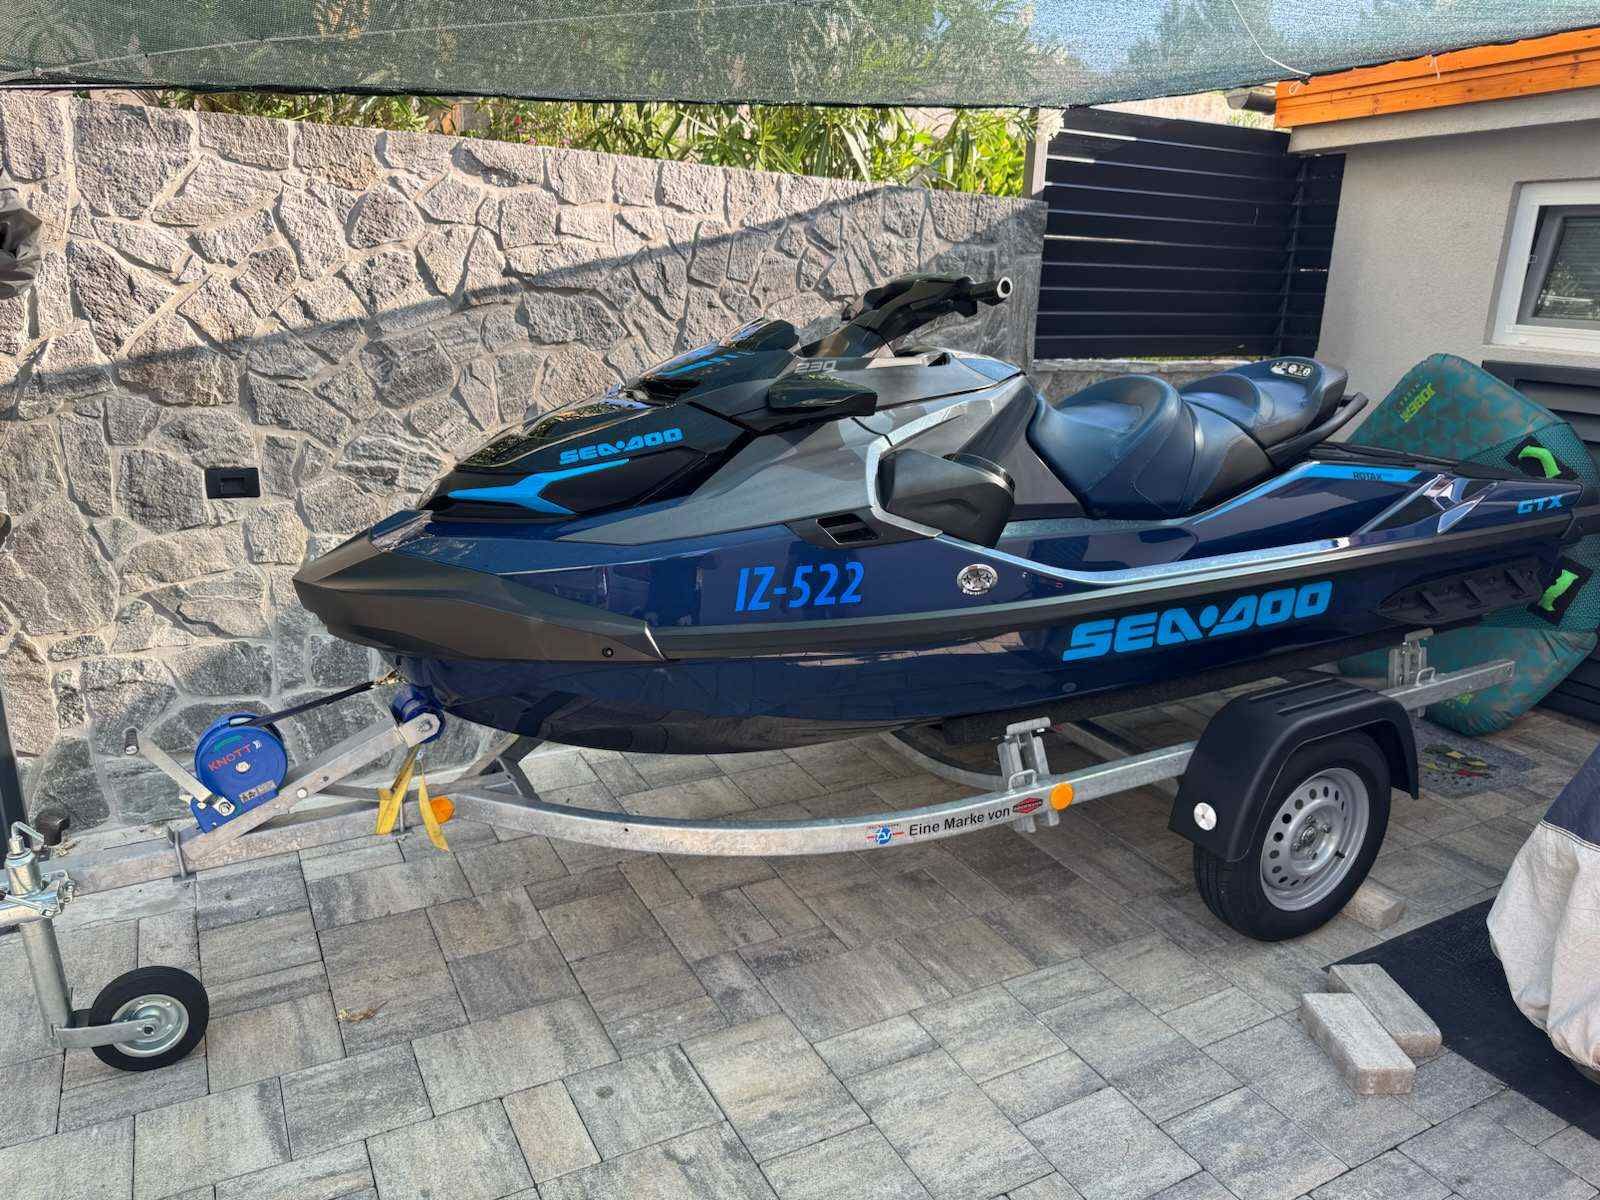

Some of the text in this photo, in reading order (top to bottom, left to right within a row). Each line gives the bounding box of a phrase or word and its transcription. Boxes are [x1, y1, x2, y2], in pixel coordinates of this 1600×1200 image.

[1516, 494, 1564, 514] GTX
[735, 561, 865, 612] IZ-522
[208, 744, 251, 771] KNOTT
[909, 822, 940, 836] Eine
[944, 812, 984, 830] Marke
[988, 807, 1010, 820] von
